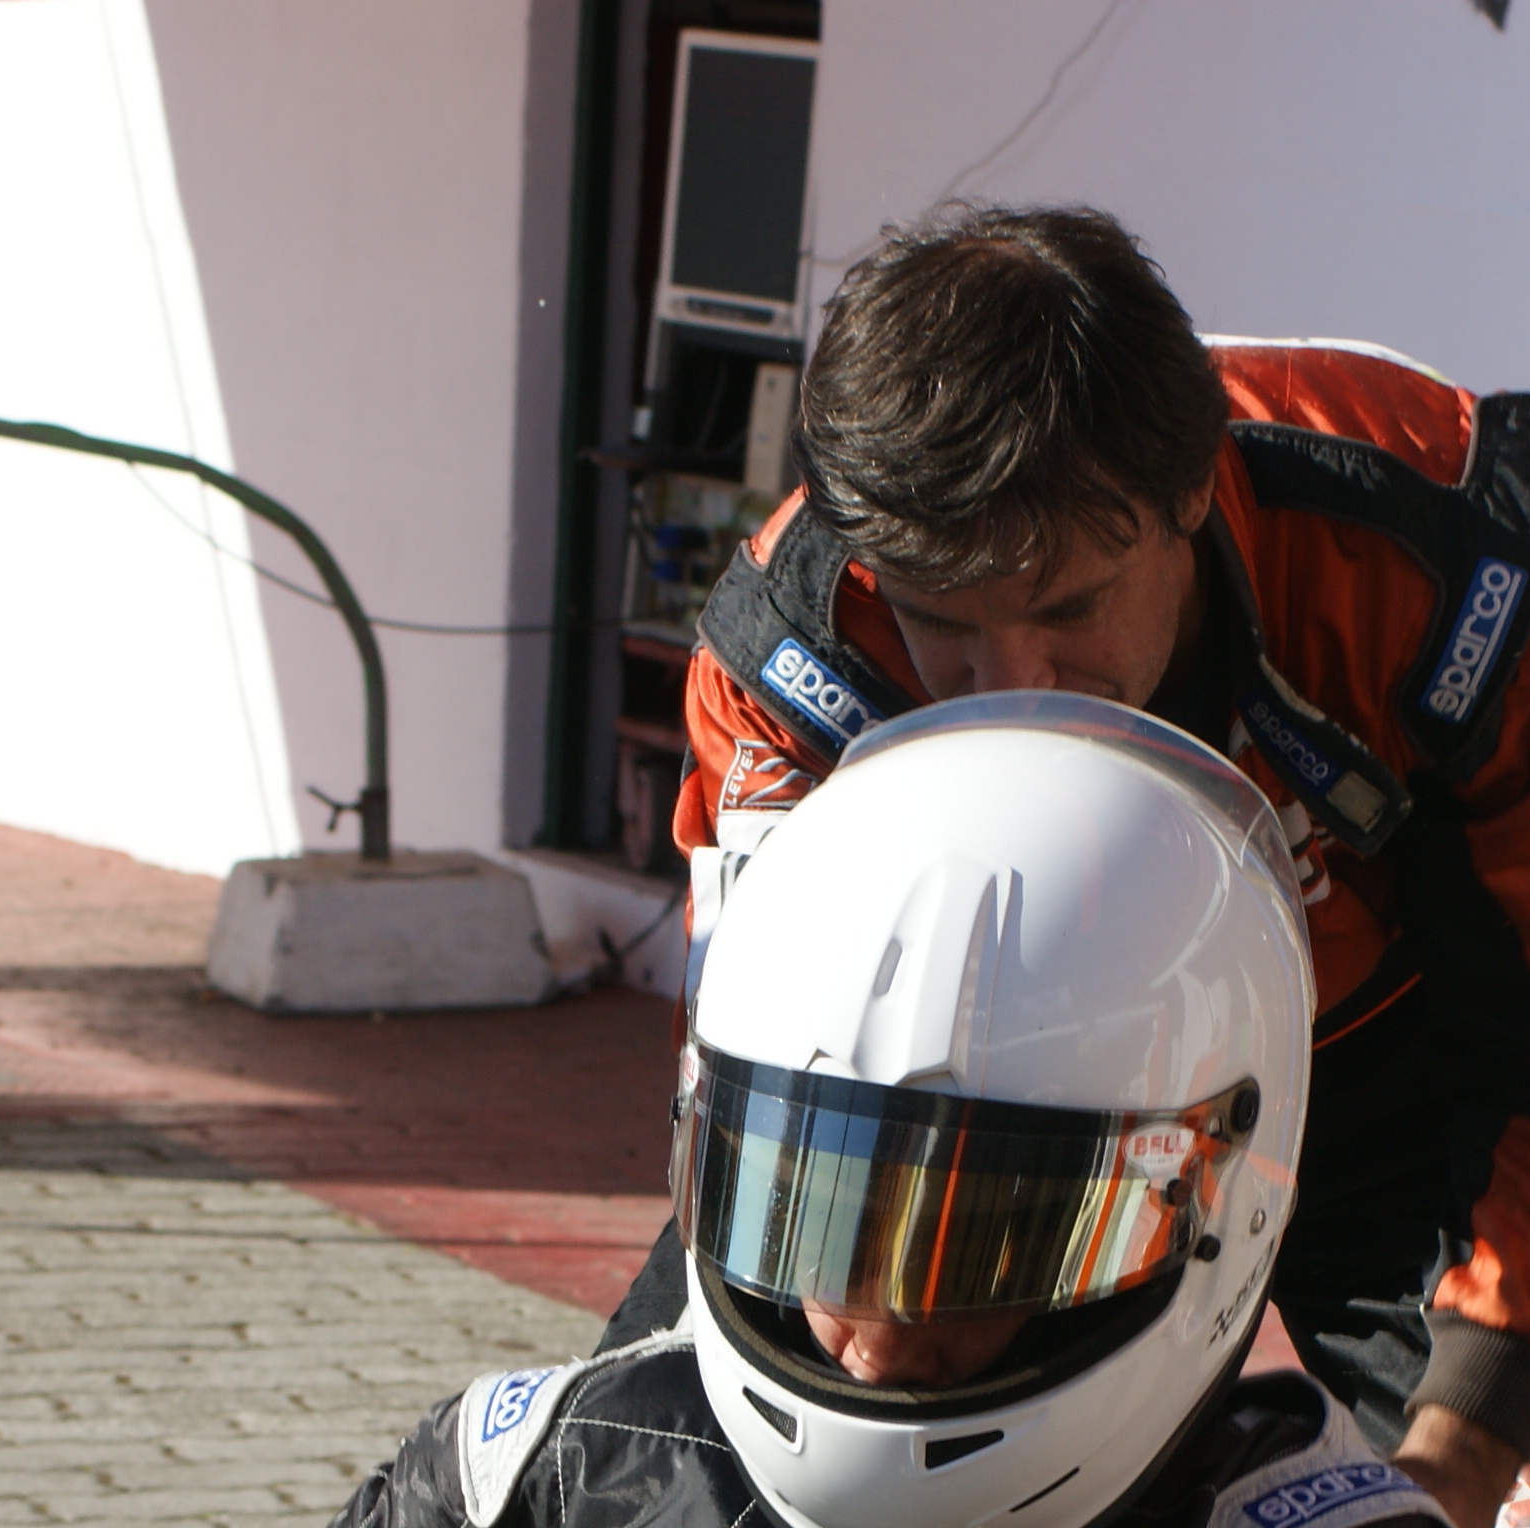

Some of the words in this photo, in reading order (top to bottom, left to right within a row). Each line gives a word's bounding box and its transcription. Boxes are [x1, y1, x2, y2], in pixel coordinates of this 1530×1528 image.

[1427, 562, 1521, 722] sparco
[767, 648, 883, 740] spar
[724, 748, 755, 808] LEVEL
[1248, 701, 1329, 786] sparco
[1133, 1132, 1189, 1156] BELL
